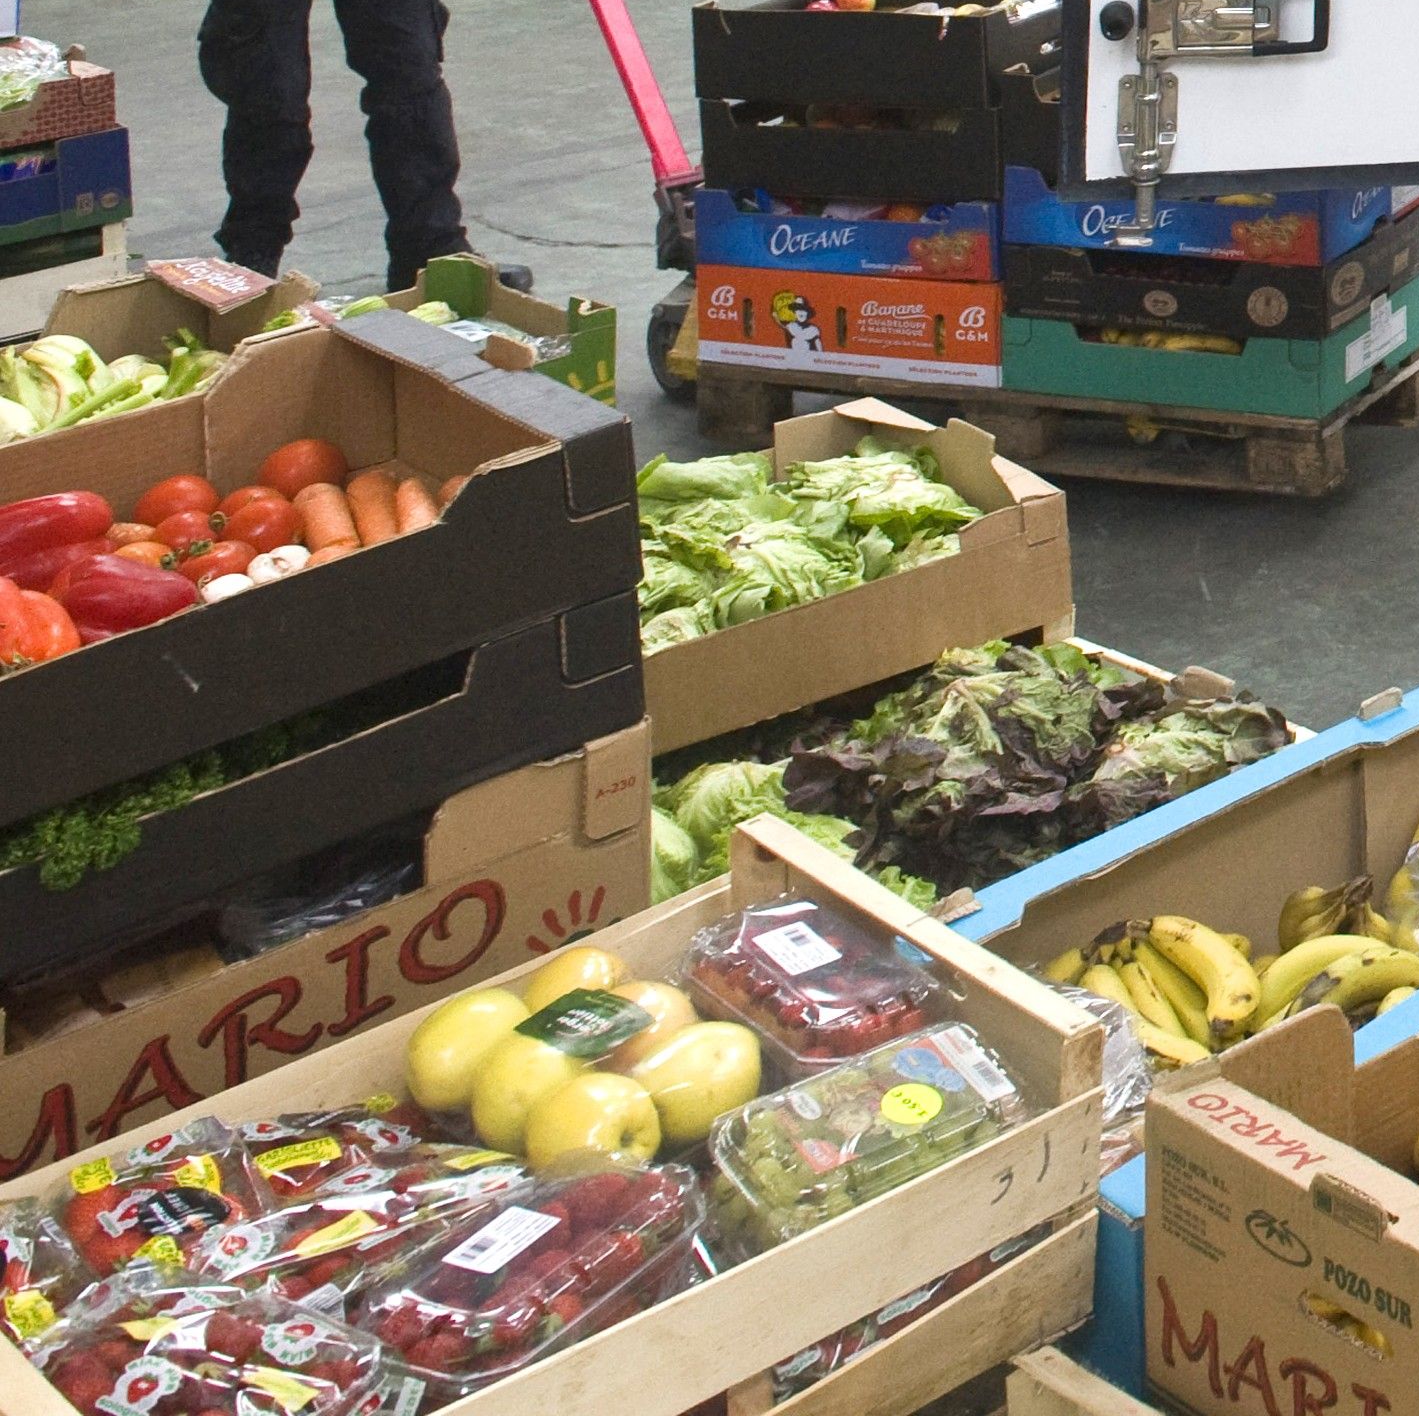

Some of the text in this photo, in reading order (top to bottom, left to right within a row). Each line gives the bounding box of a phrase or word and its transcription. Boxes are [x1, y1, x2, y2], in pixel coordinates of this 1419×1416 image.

[1082, 204, 1176, 237] OCEE
[861, 300, 932, 321] Banane
[595, 775, 637, 799] A-230
[1187, 1093, 1327, 1171] MARIO
[1323, 1256, 1372, 1305] POZO
[1373, 1286, 1413, 1329] SUR
